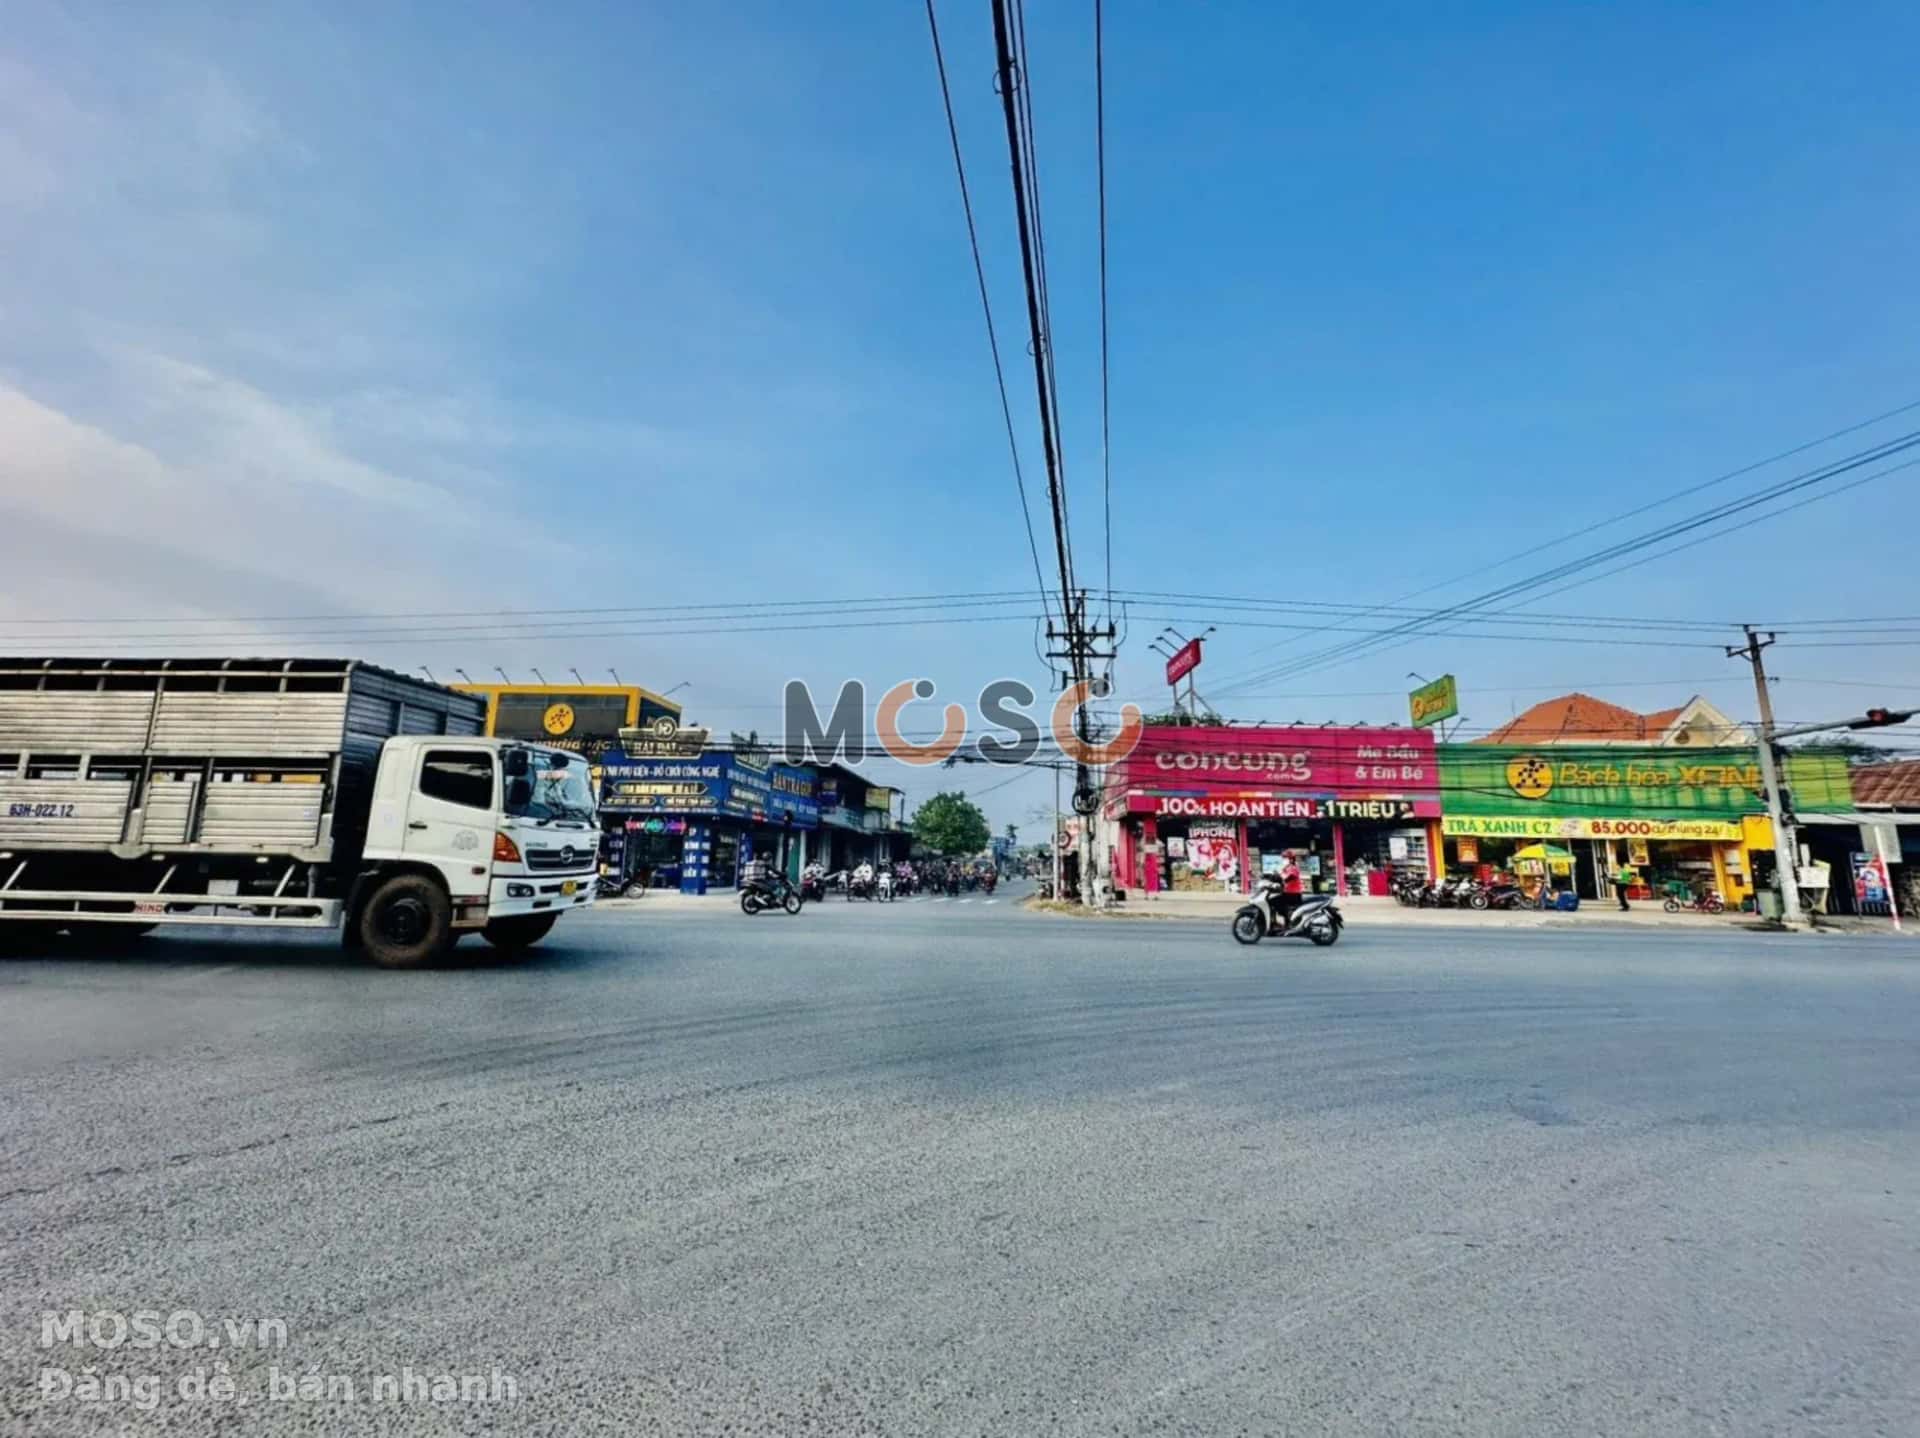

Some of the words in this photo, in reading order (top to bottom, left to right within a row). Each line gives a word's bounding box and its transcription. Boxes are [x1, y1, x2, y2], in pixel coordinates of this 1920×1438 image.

[1356, 766, 1367, 779] &
[1372, 766, 1397, 779] Em
[1483, 820, 1526, 834] XANH
[1532, 821, 1552, 834] C2
